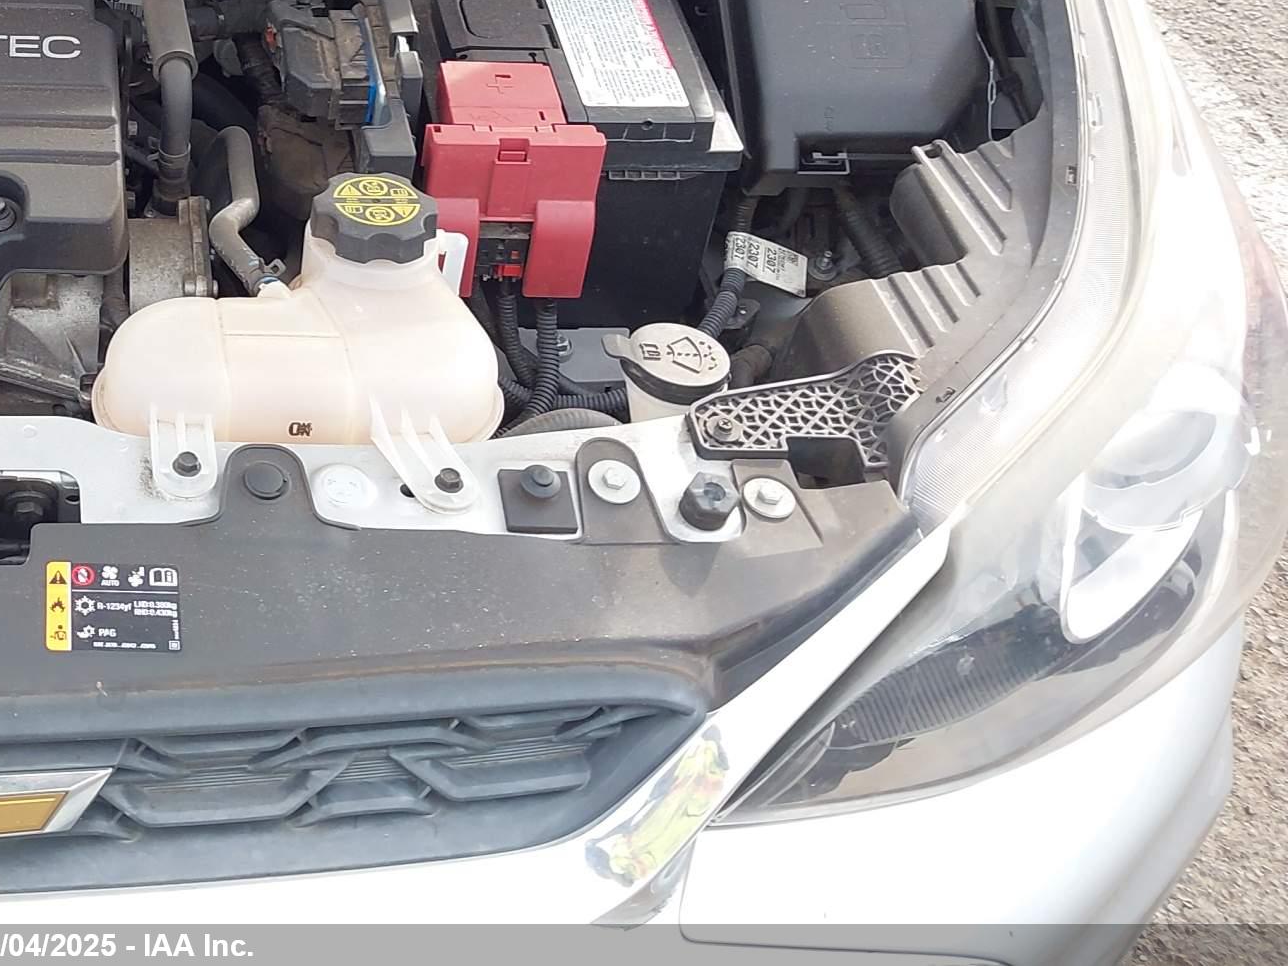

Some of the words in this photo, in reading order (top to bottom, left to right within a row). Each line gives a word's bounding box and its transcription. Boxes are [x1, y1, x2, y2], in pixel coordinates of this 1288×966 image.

[747, 243, 760, 269] 2307
[766, 247, 777, 274] 2307
[100, 579, 120, 587] AUTO
[97, 602, 132, 612] R-1234yf
[98, 628, 117, 638] PAG
